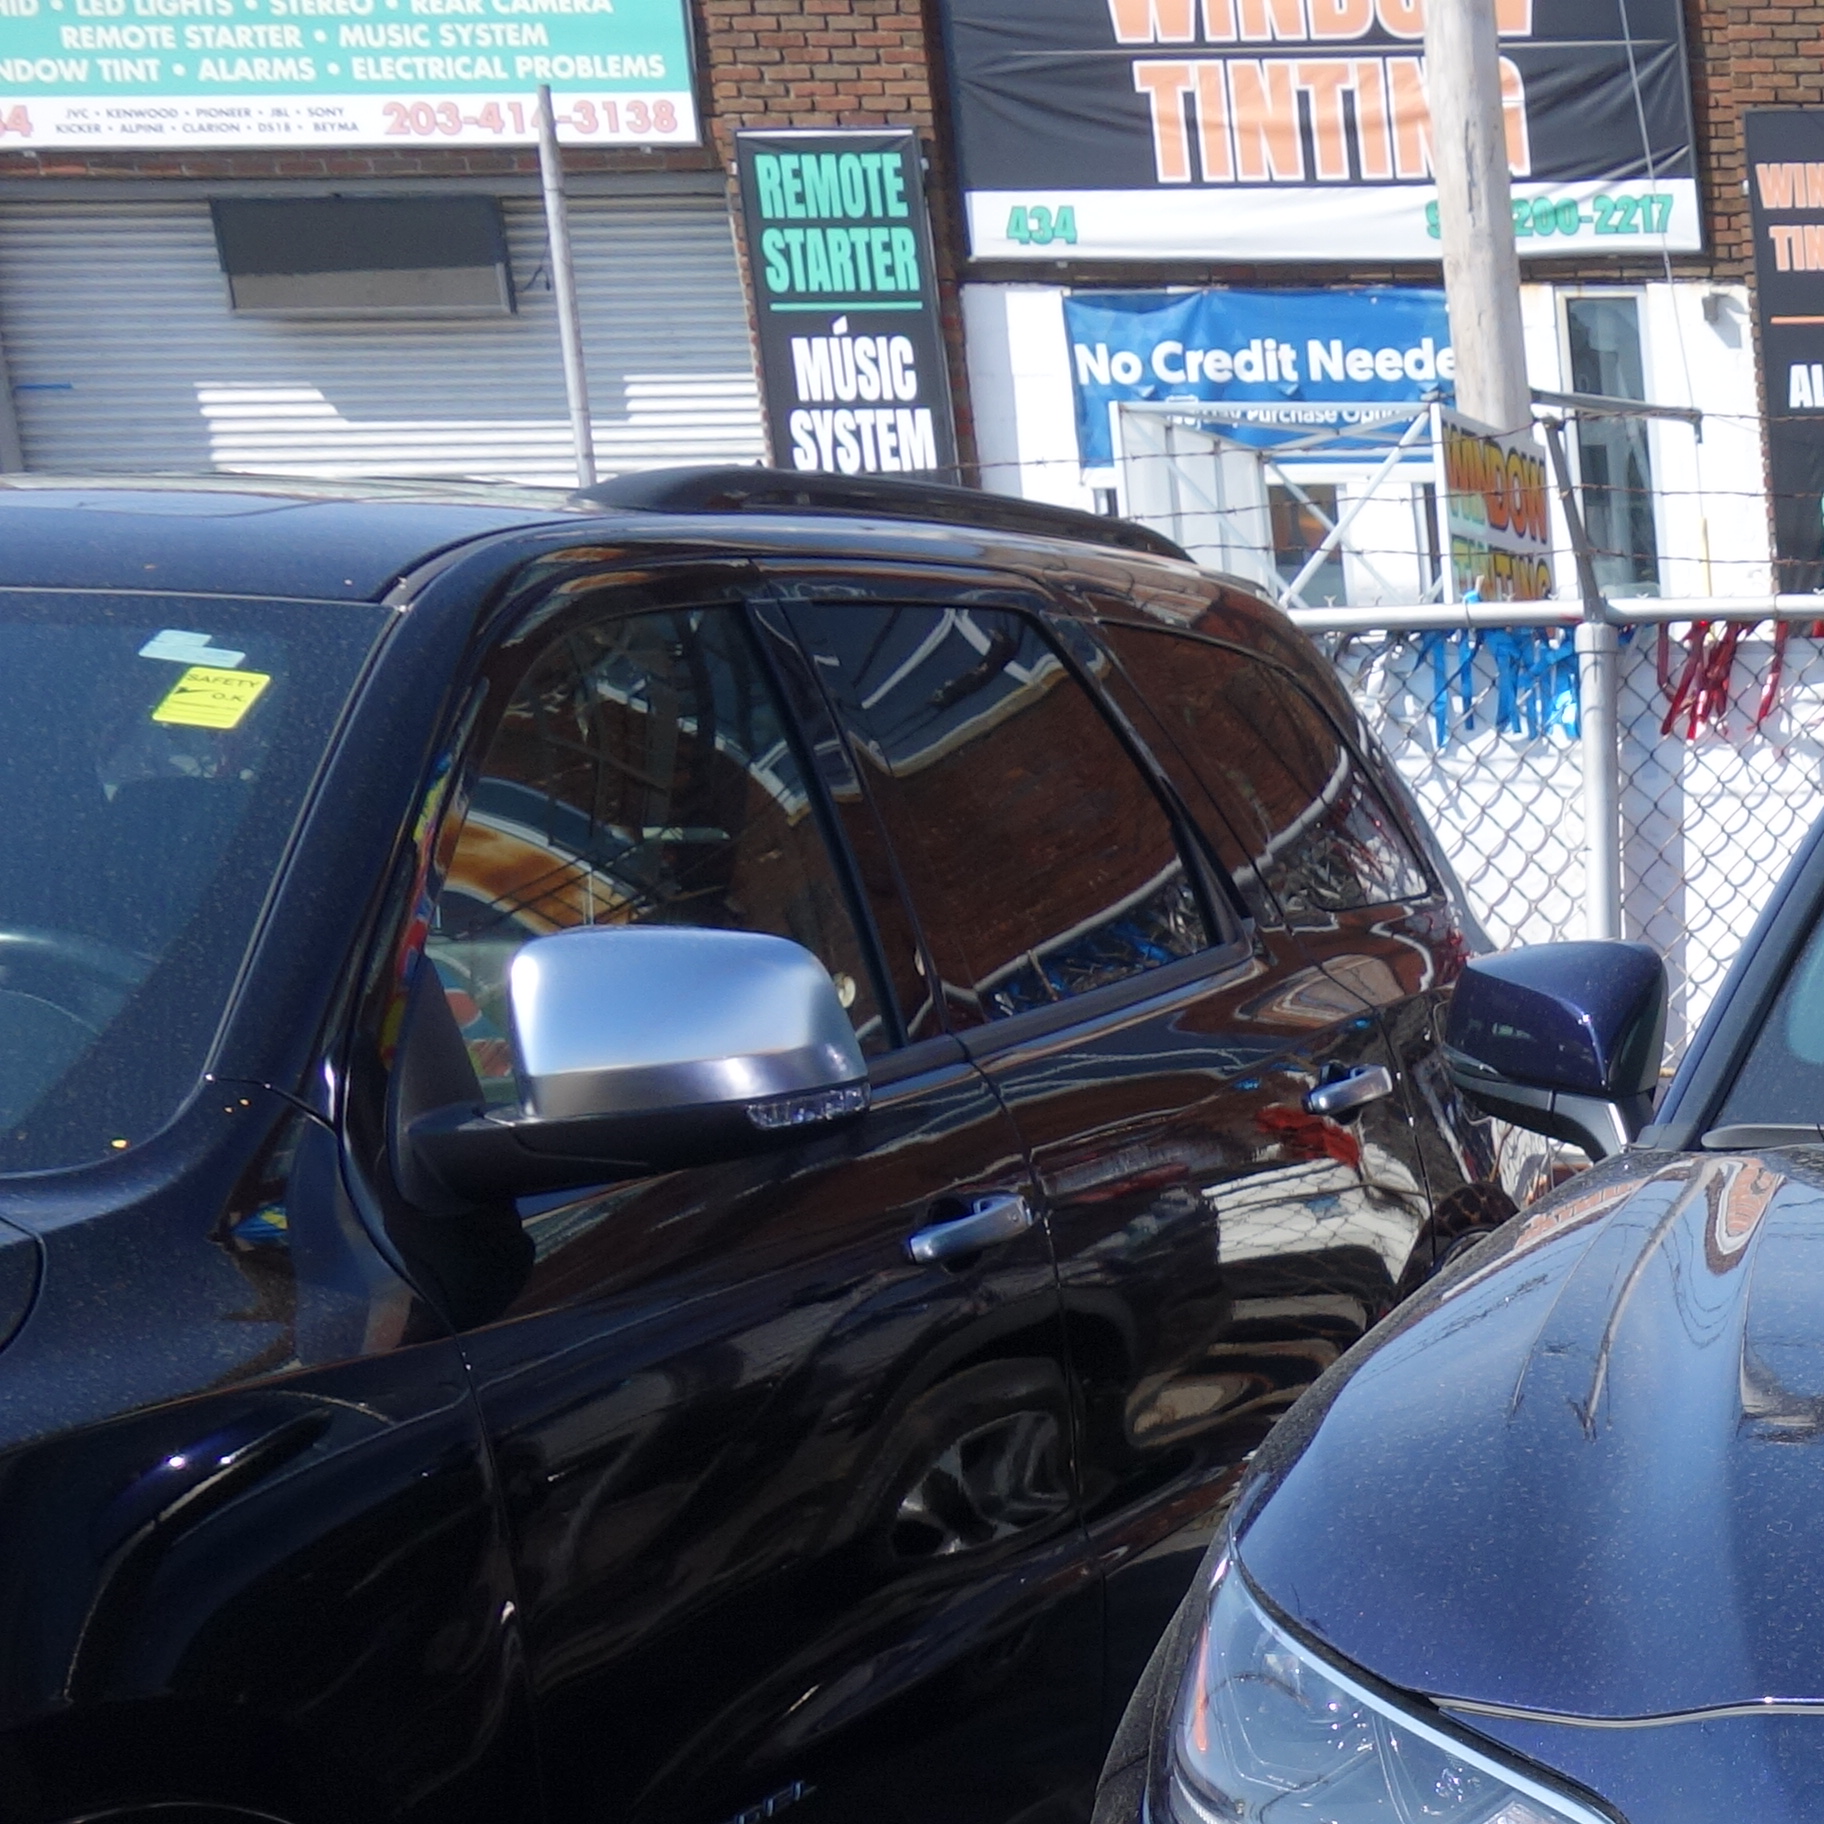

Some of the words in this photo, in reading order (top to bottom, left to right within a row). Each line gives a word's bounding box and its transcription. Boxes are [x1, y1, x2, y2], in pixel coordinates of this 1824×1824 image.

[135, 0, 234, 16] LIGHTS
[269, 0, 374, 15] STEREO
[60, 25, 177, 49] REMOTE
[185, 24, 306, 49] STARTER
[340, 23, 431, 47] MUSIC
[440, 22, 549, 46] SYSTEM
[0, 58, 89, 82] NDOW
[96, 58, 161, 82] TINT
[198, 57, 317, 82] ALARMS
[352, 56, 509, 81] ELECTRICAL
[515, 54, 666, 79] PROBLEMS
[55, 123, 102, 133] KICKER
[120, 123, 165, 133] ALPINE
[182, 122, 240, 133] CLARION
[313, 122, 359, 132] BEYMA
[66, 108, 89, 118] JVC
[106, 108, 178, 118] KENWOOD
[196, 107, 250, 117] PIONEER
[307, 107, 344, 117] SONY
[755, 153, 909, 218] REMOTE
[1006, 205, 1078, 245] 434
[761, 227, 920, 293] STARTER
[1074, 343, 1143, 386] No
[1151, 338, 1298, 383] Credit
[1307, 337, 1456, 383] Neede
[790, 408, 938, 474] SYSTEM
[1442, 418, 1547, 546] WINDOW
[187, 673, 261, 688] SAFETY
